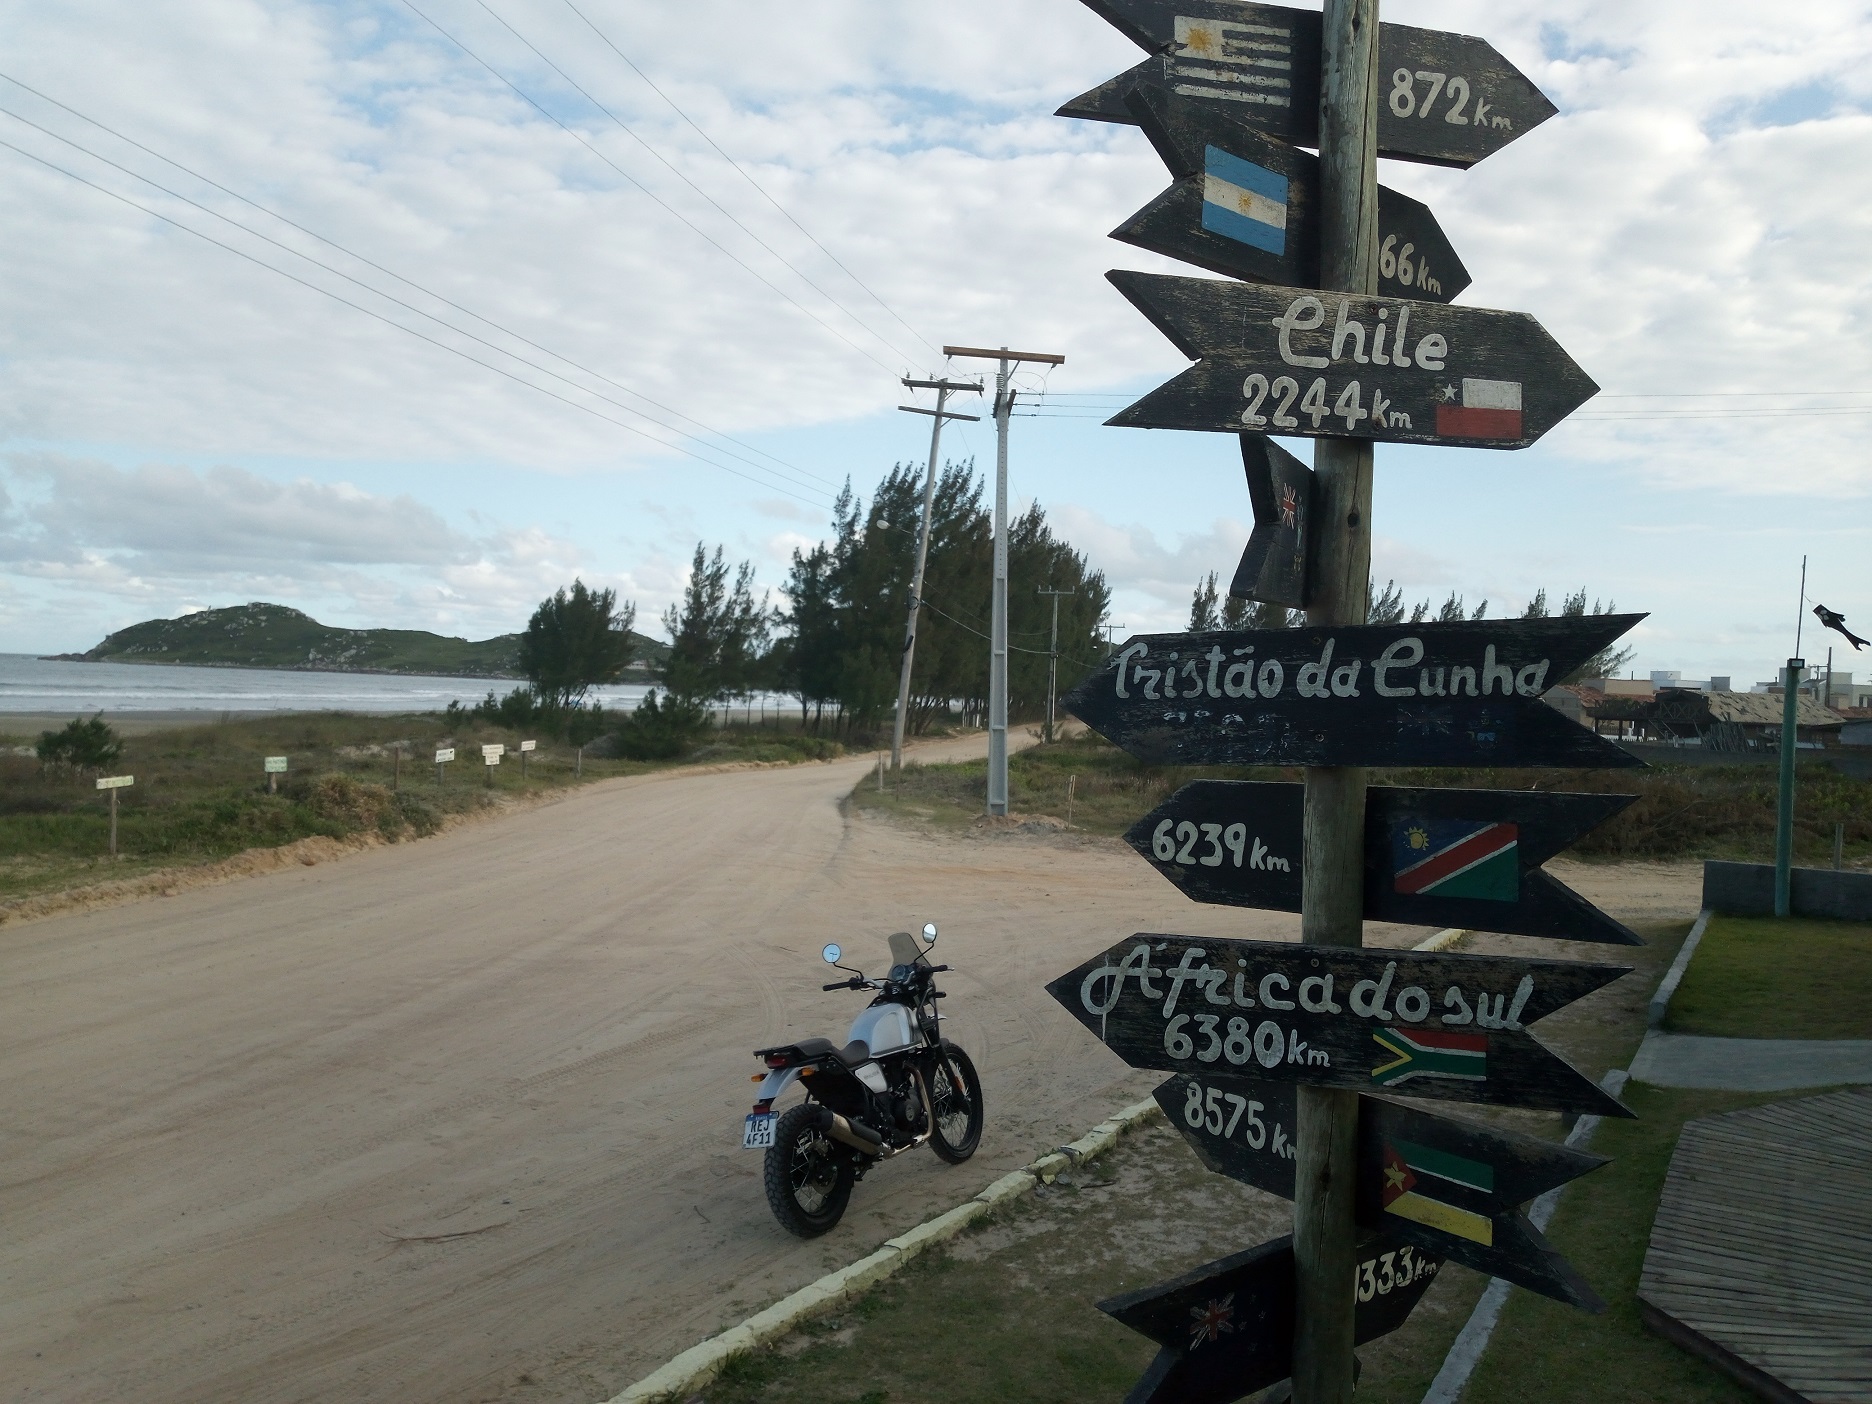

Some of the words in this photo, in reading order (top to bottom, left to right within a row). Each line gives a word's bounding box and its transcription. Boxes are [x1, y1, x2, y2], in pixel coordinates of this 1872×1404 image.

[1272, 296, 1448, 370] Chile
[1109, 642, 1284, 700] Tristão
[1296, 637, 1361, 698] da
[1373, 637, 1550, 698] Cunha
[746, 1132, 771, 1146] 4F11
[750, 1120, 770, 1132] REJ
